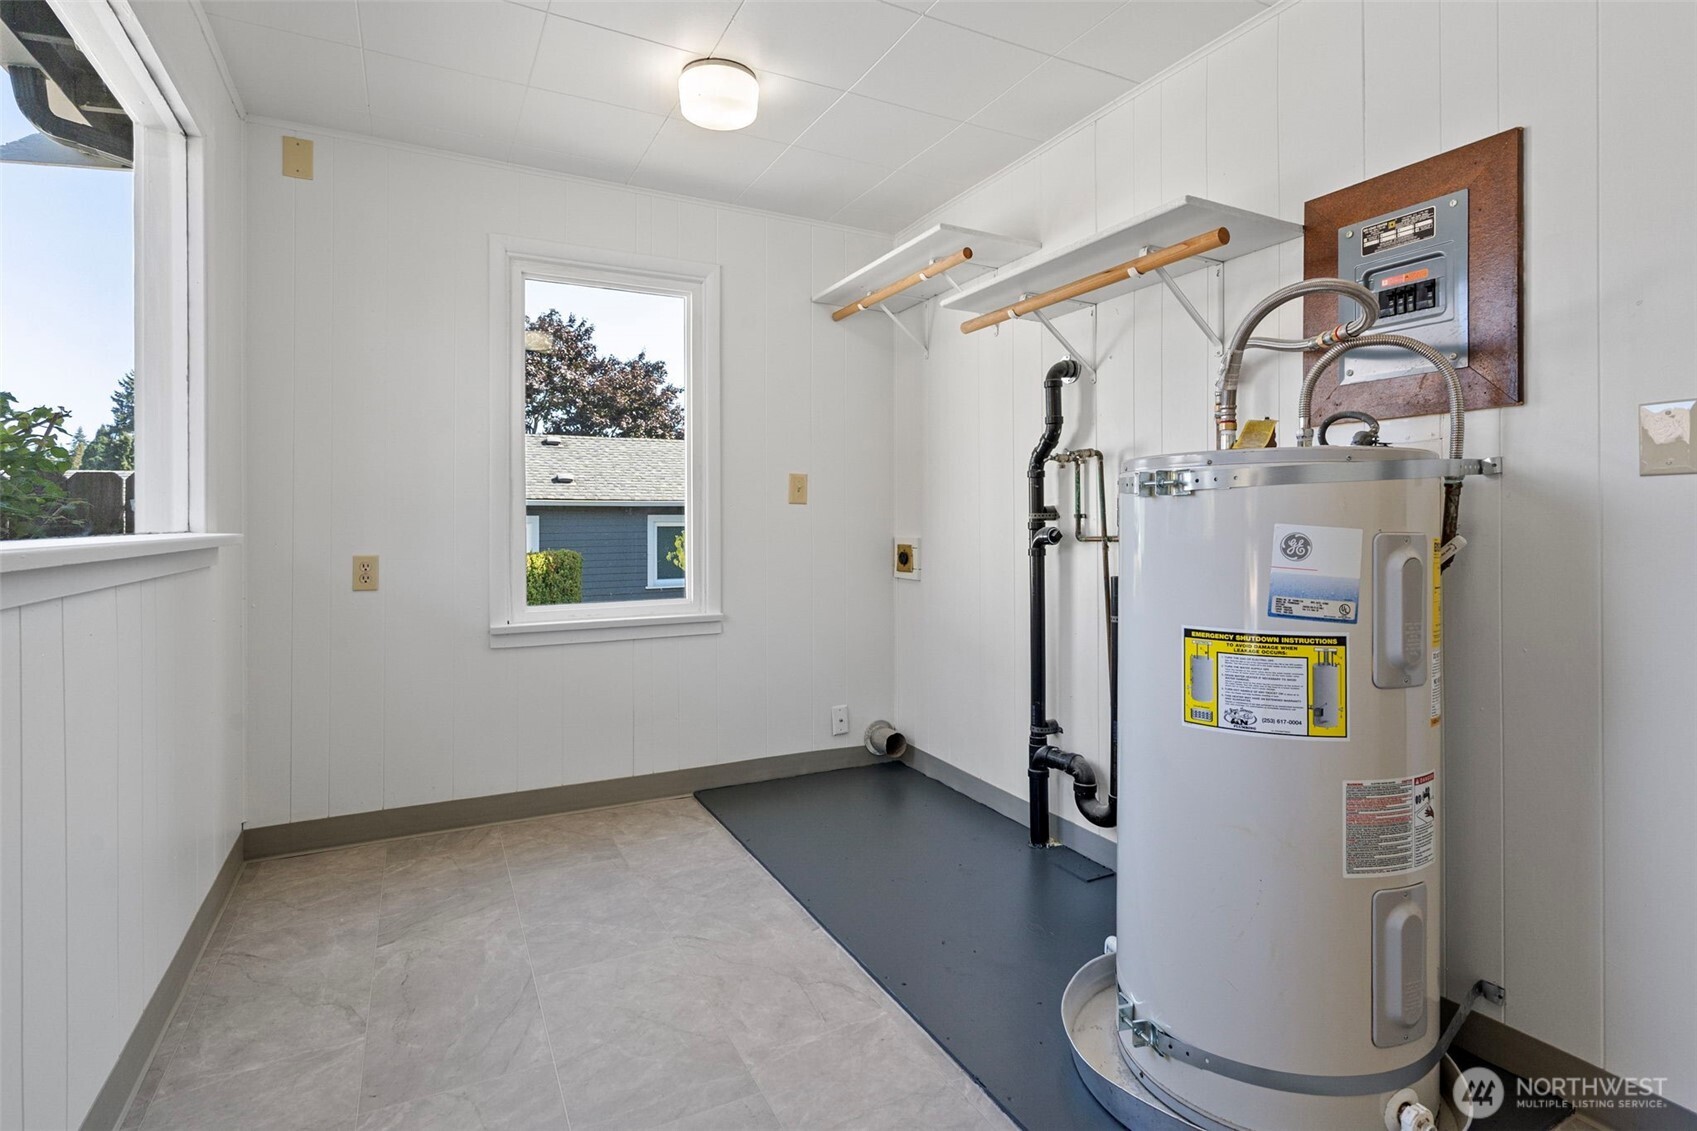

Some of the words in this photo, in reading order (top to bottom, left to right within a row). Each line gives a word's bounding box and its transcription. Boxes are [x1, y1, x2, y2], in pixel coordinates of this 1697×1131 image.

[1191, 631, 1234, 640] EMERGENCY
[1235, 634, 1279, 644] SHUTDOWN
[1281, 636, 1338, 645] INSTRUCTIONS
[1262, 717, 1275, 725] (253)
[1276, 717, 1303, 726] 617-0004
